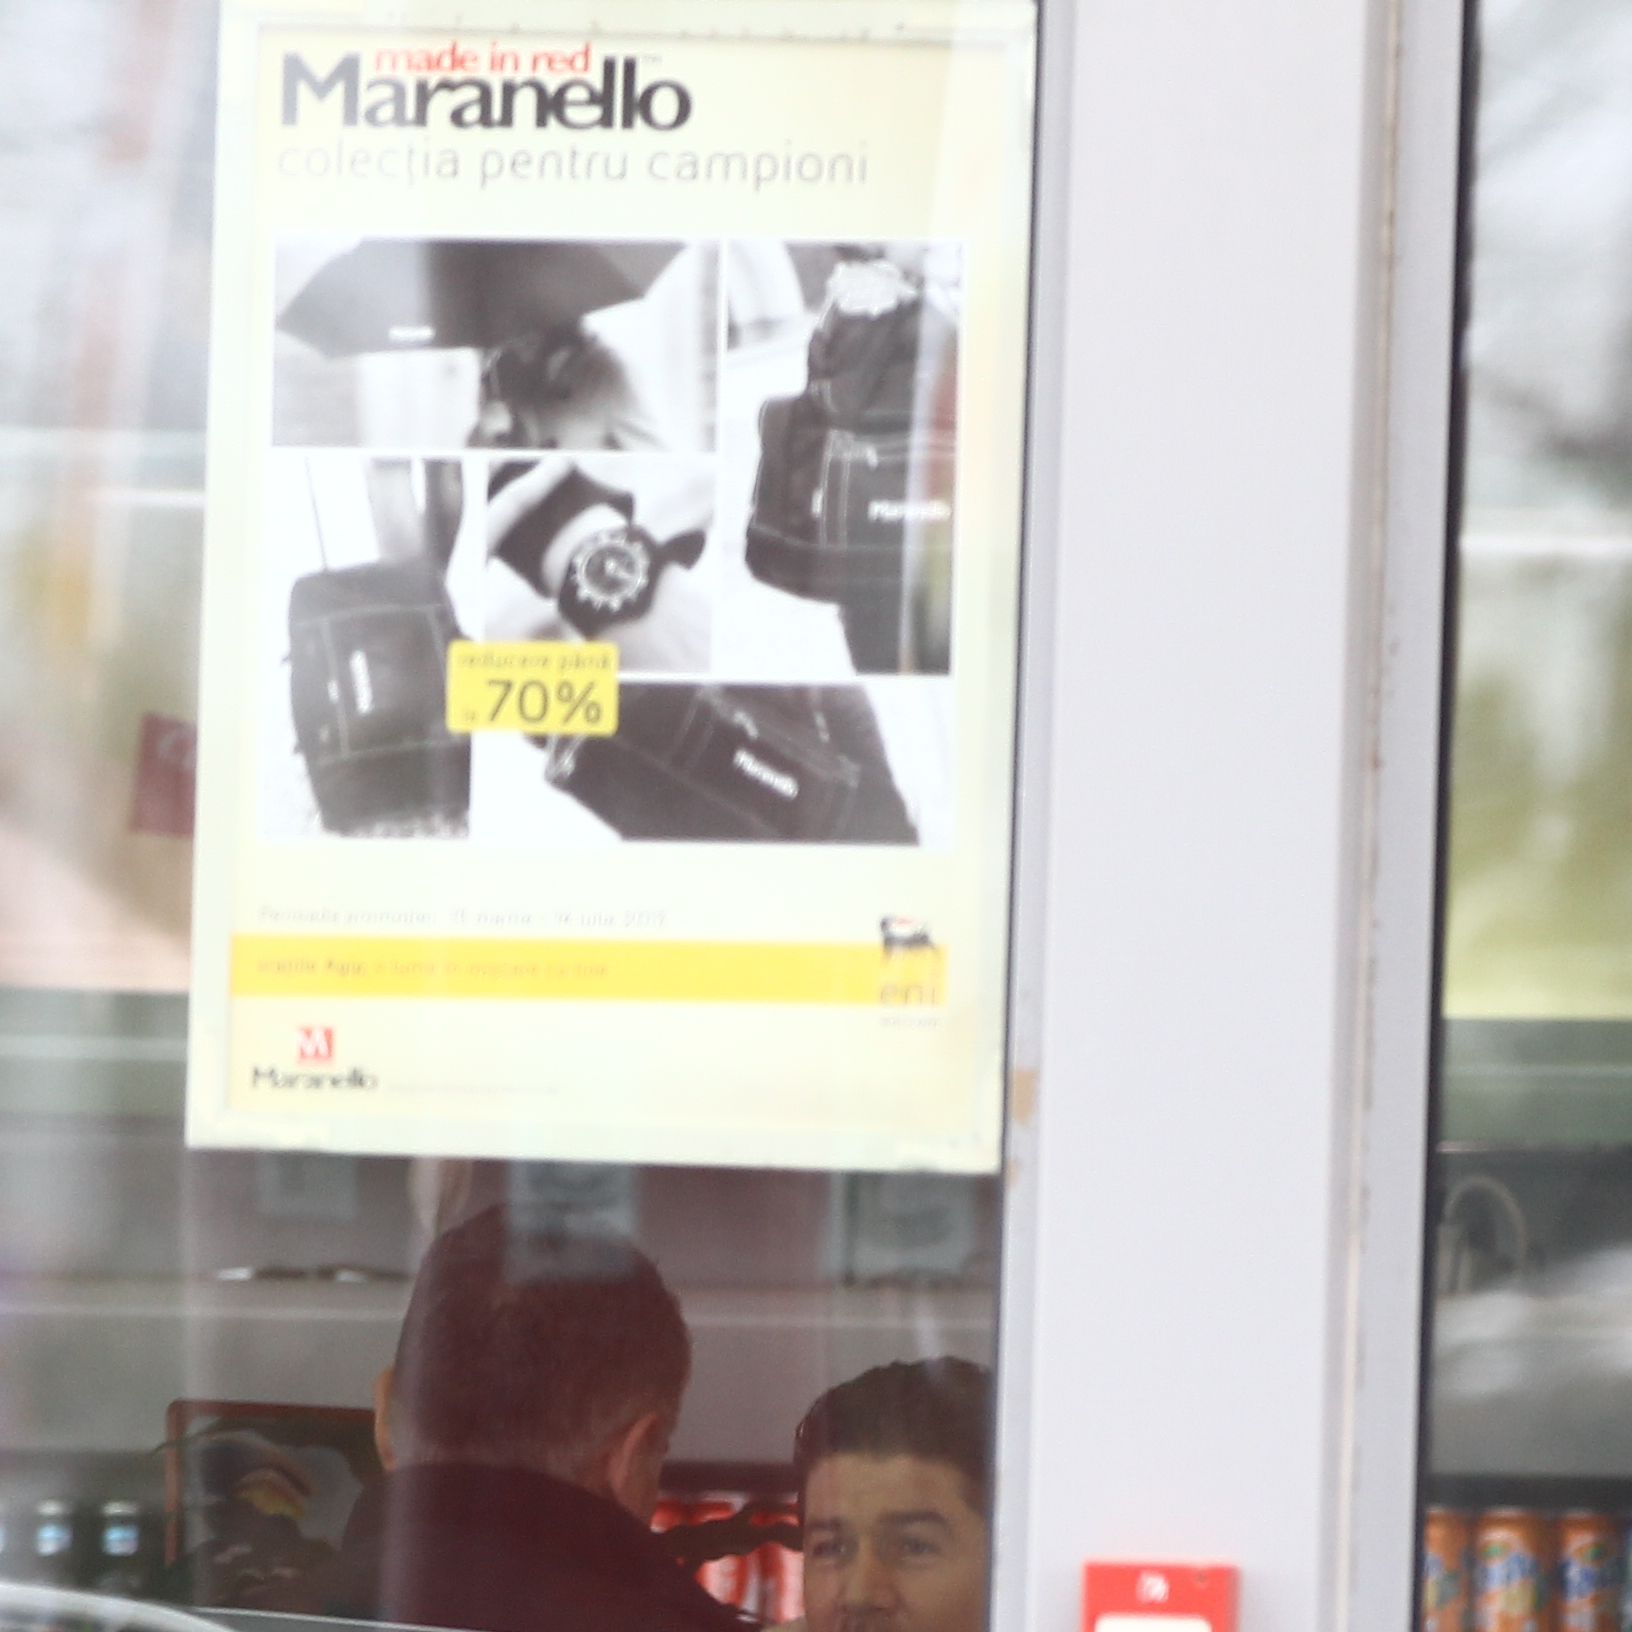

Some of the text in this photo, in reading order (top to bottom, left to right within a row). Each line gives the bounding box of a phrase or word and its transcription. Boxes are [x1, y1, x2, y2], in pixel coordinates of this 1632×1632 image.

[376, 41, 591, 73] made in red
[280, 52, 693, 131] Maranello
[478, 147, 627, 190] pentru
[647, 140, 868, 192] campioni
[487, 678, 603, 724] 70%
